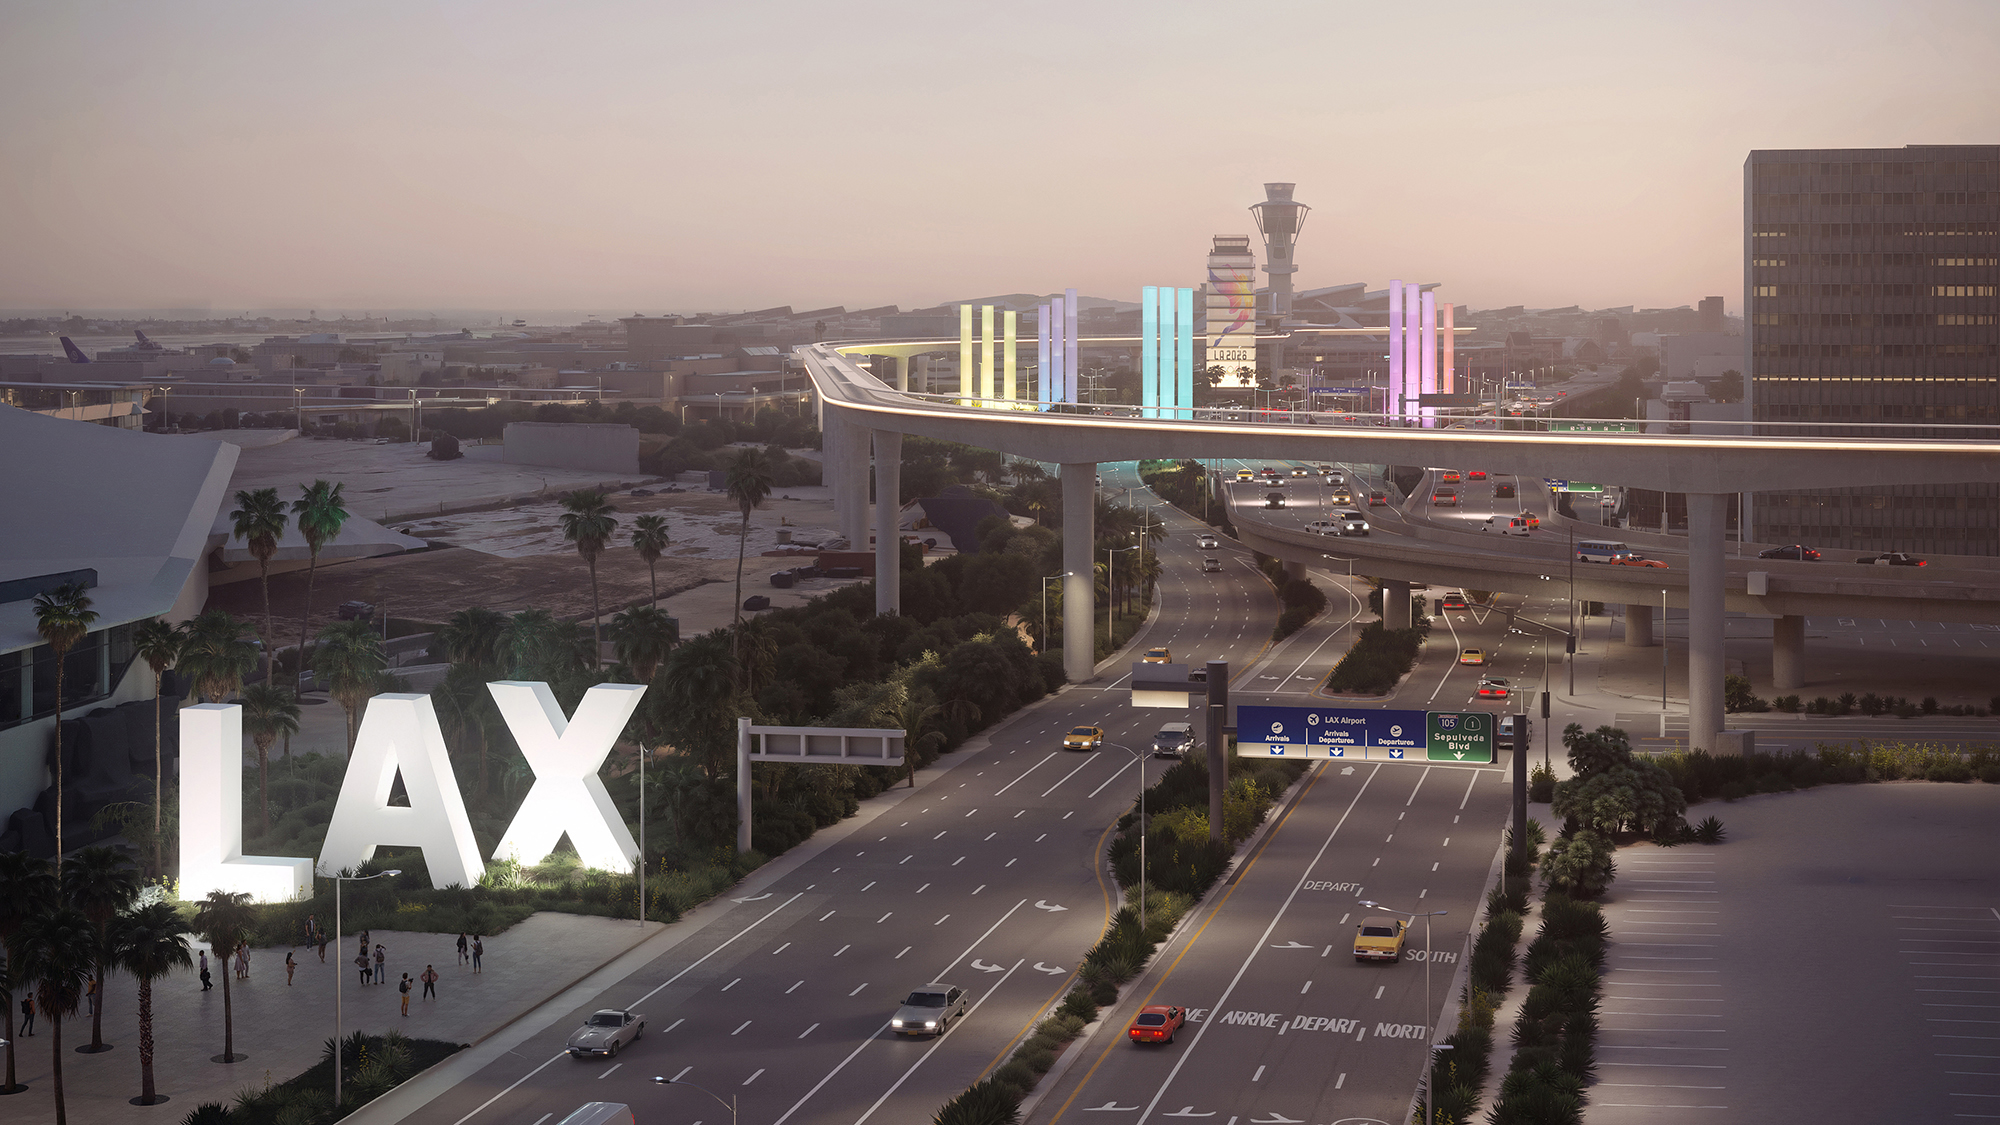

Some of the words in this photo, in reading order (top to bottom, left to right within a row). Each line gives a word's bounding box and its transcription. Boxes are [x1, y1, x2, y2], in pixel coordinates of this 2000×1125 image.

[1213, 349, 1225, 361] LA
[1324, 716, 1340, 724] LAX
[1340, 716, 1366, 726] Airport
[1441, 718, 1455, 728] 105
[1264, 734, 1291, 742] Arrivals
[1324, 729, 1349, 737] Arrivals
[1434, 732, 1485, 743] Sepulveda
[1318, 736, 1355, 744] Departures
[1378, 738, 1415, 746] Departures
[1448, 741, 1470, 750] Blvd
[178, 680, 649, 903] LAX
[1303, 880, 1361, 892] DEPART
[1219, 1010, 1283, 1028] ARRIVE
[1291, 1015, 1360, 1034] DEPART
